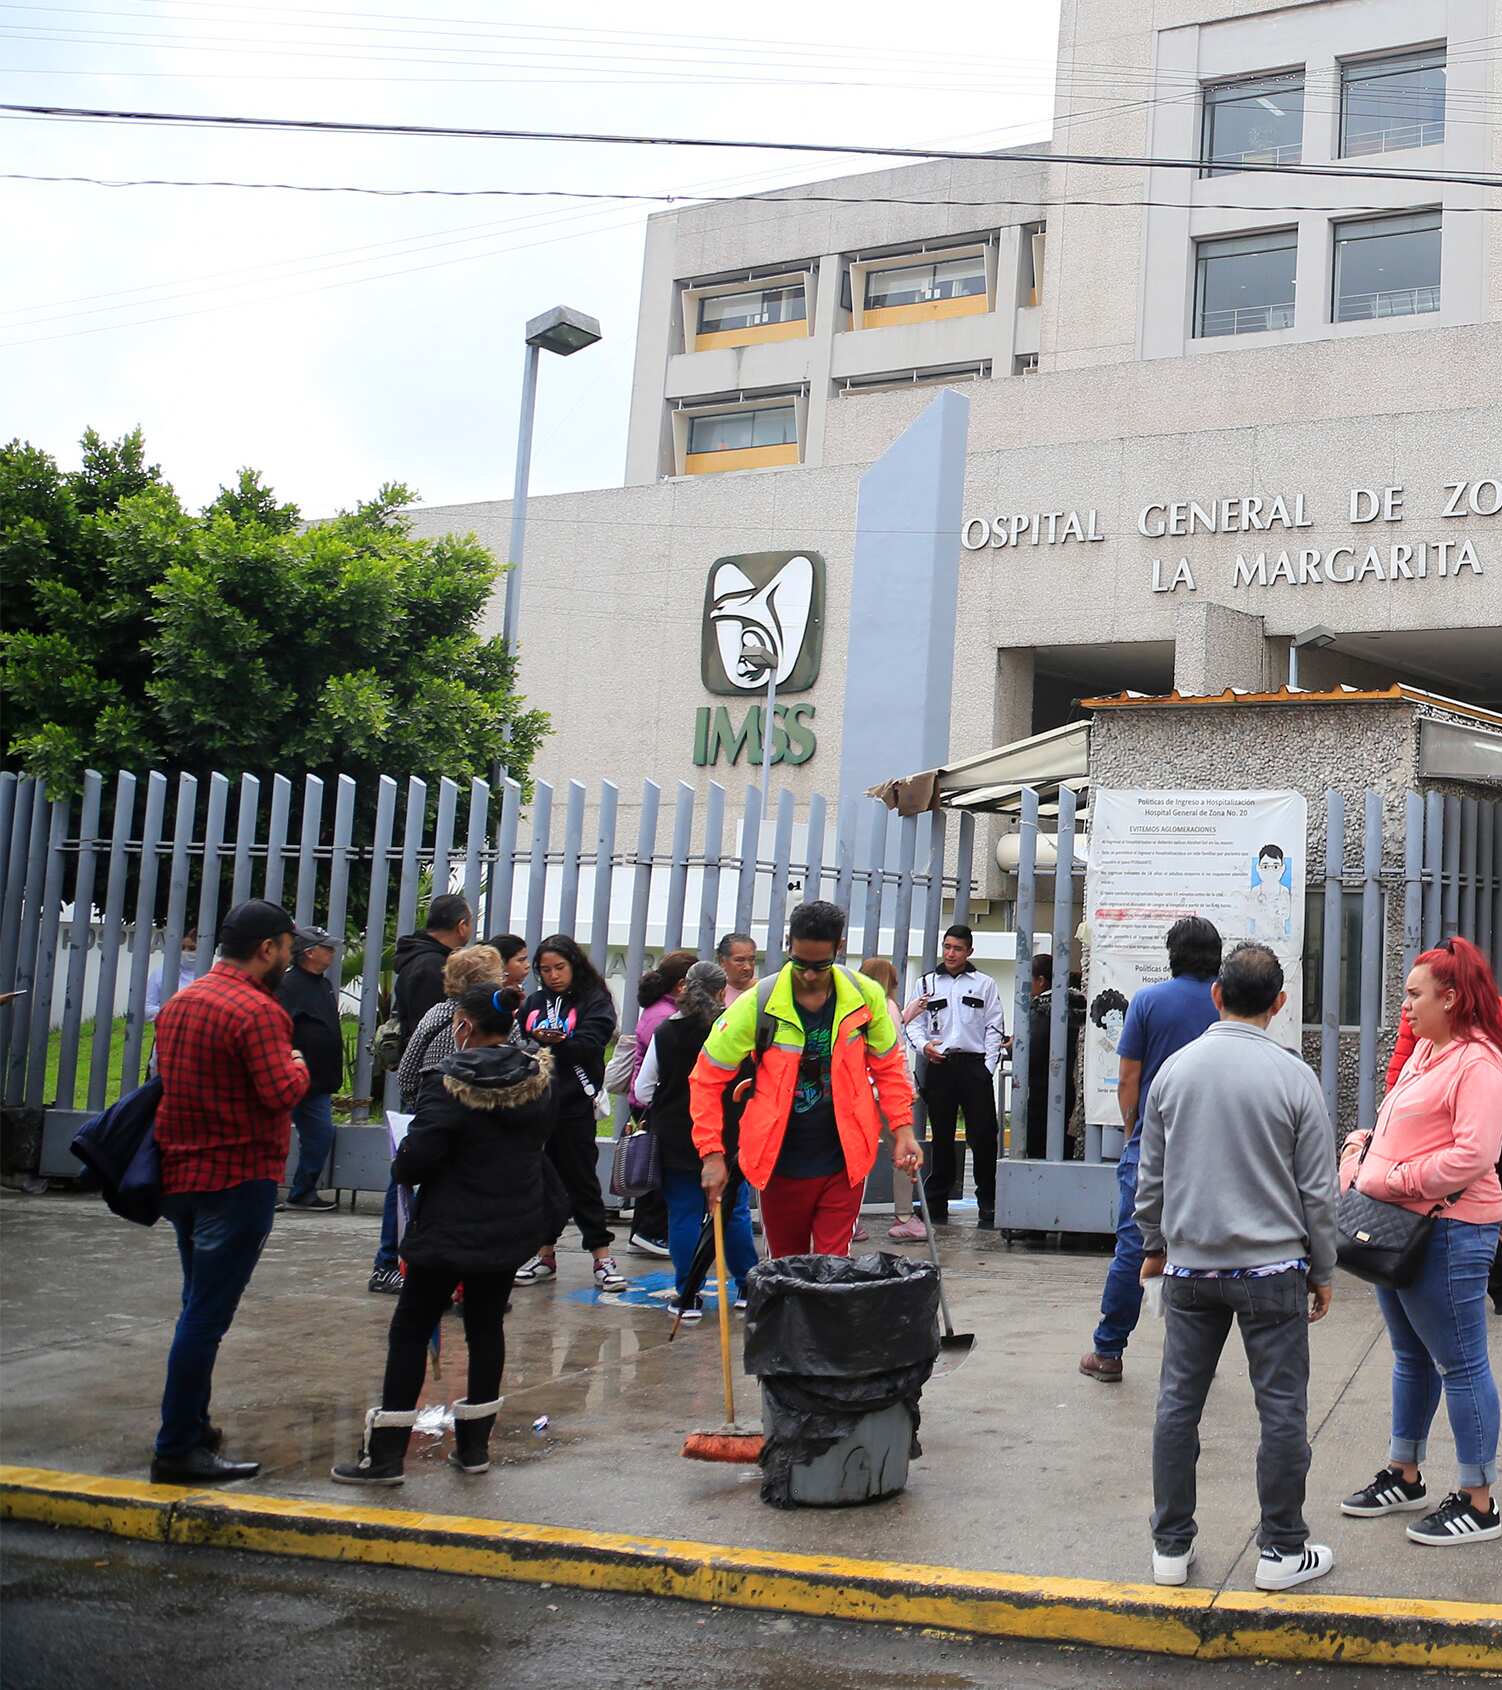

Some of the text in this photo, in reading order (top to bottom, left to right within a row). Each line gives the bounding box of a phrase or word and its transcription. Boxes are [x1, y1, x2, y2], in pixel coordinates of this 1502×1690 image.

[960, 508, 1105, 551] OSPITAL
[1137, 492, 1314, 539] GENERAL
[1349, 485, 1405, 525] DE
[1150, 538, 1484, 593] LA MARGARITA
[692, 702, 818, 767] IMSS
[1144, 808, 1172, 818] Hospital
[1172, 808, 1198, 817] General
[1198, 808, 1208, 817] de
[1208, 808, 1225, 817] Zona
[1239, 809, 1248, 817] 20
[1175, 798, 1200, 808] Ingreso
[1129, 825, 1160, 833] EVITEMOS
